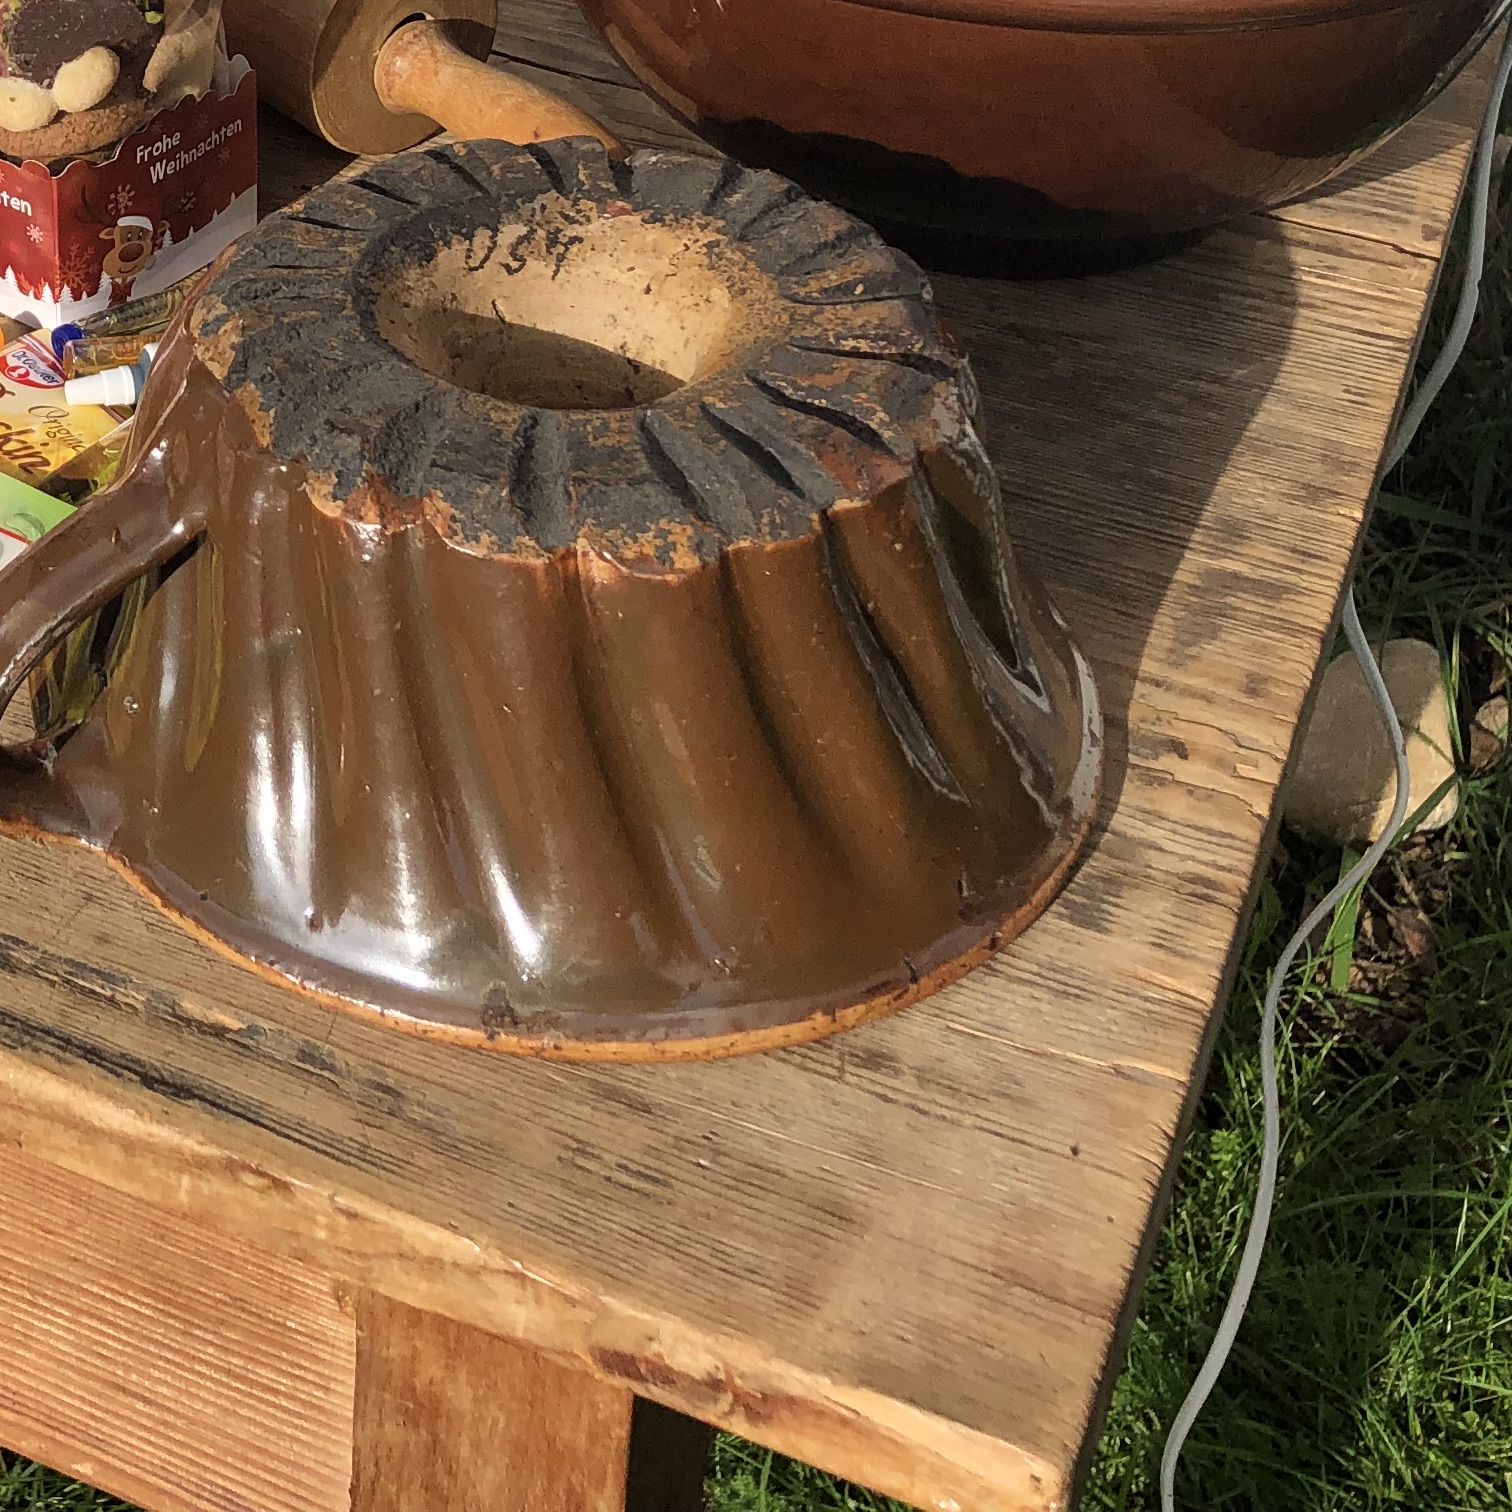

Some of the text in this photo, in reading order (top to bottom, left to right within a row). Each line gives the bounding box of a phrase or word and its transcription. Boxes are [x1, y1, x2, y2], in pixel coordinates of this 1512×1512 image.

[135, 130, 181, 165] Frohe
[149, 117, 242, 185] Weihnachten
[28, 405, 88, 453] Origina
